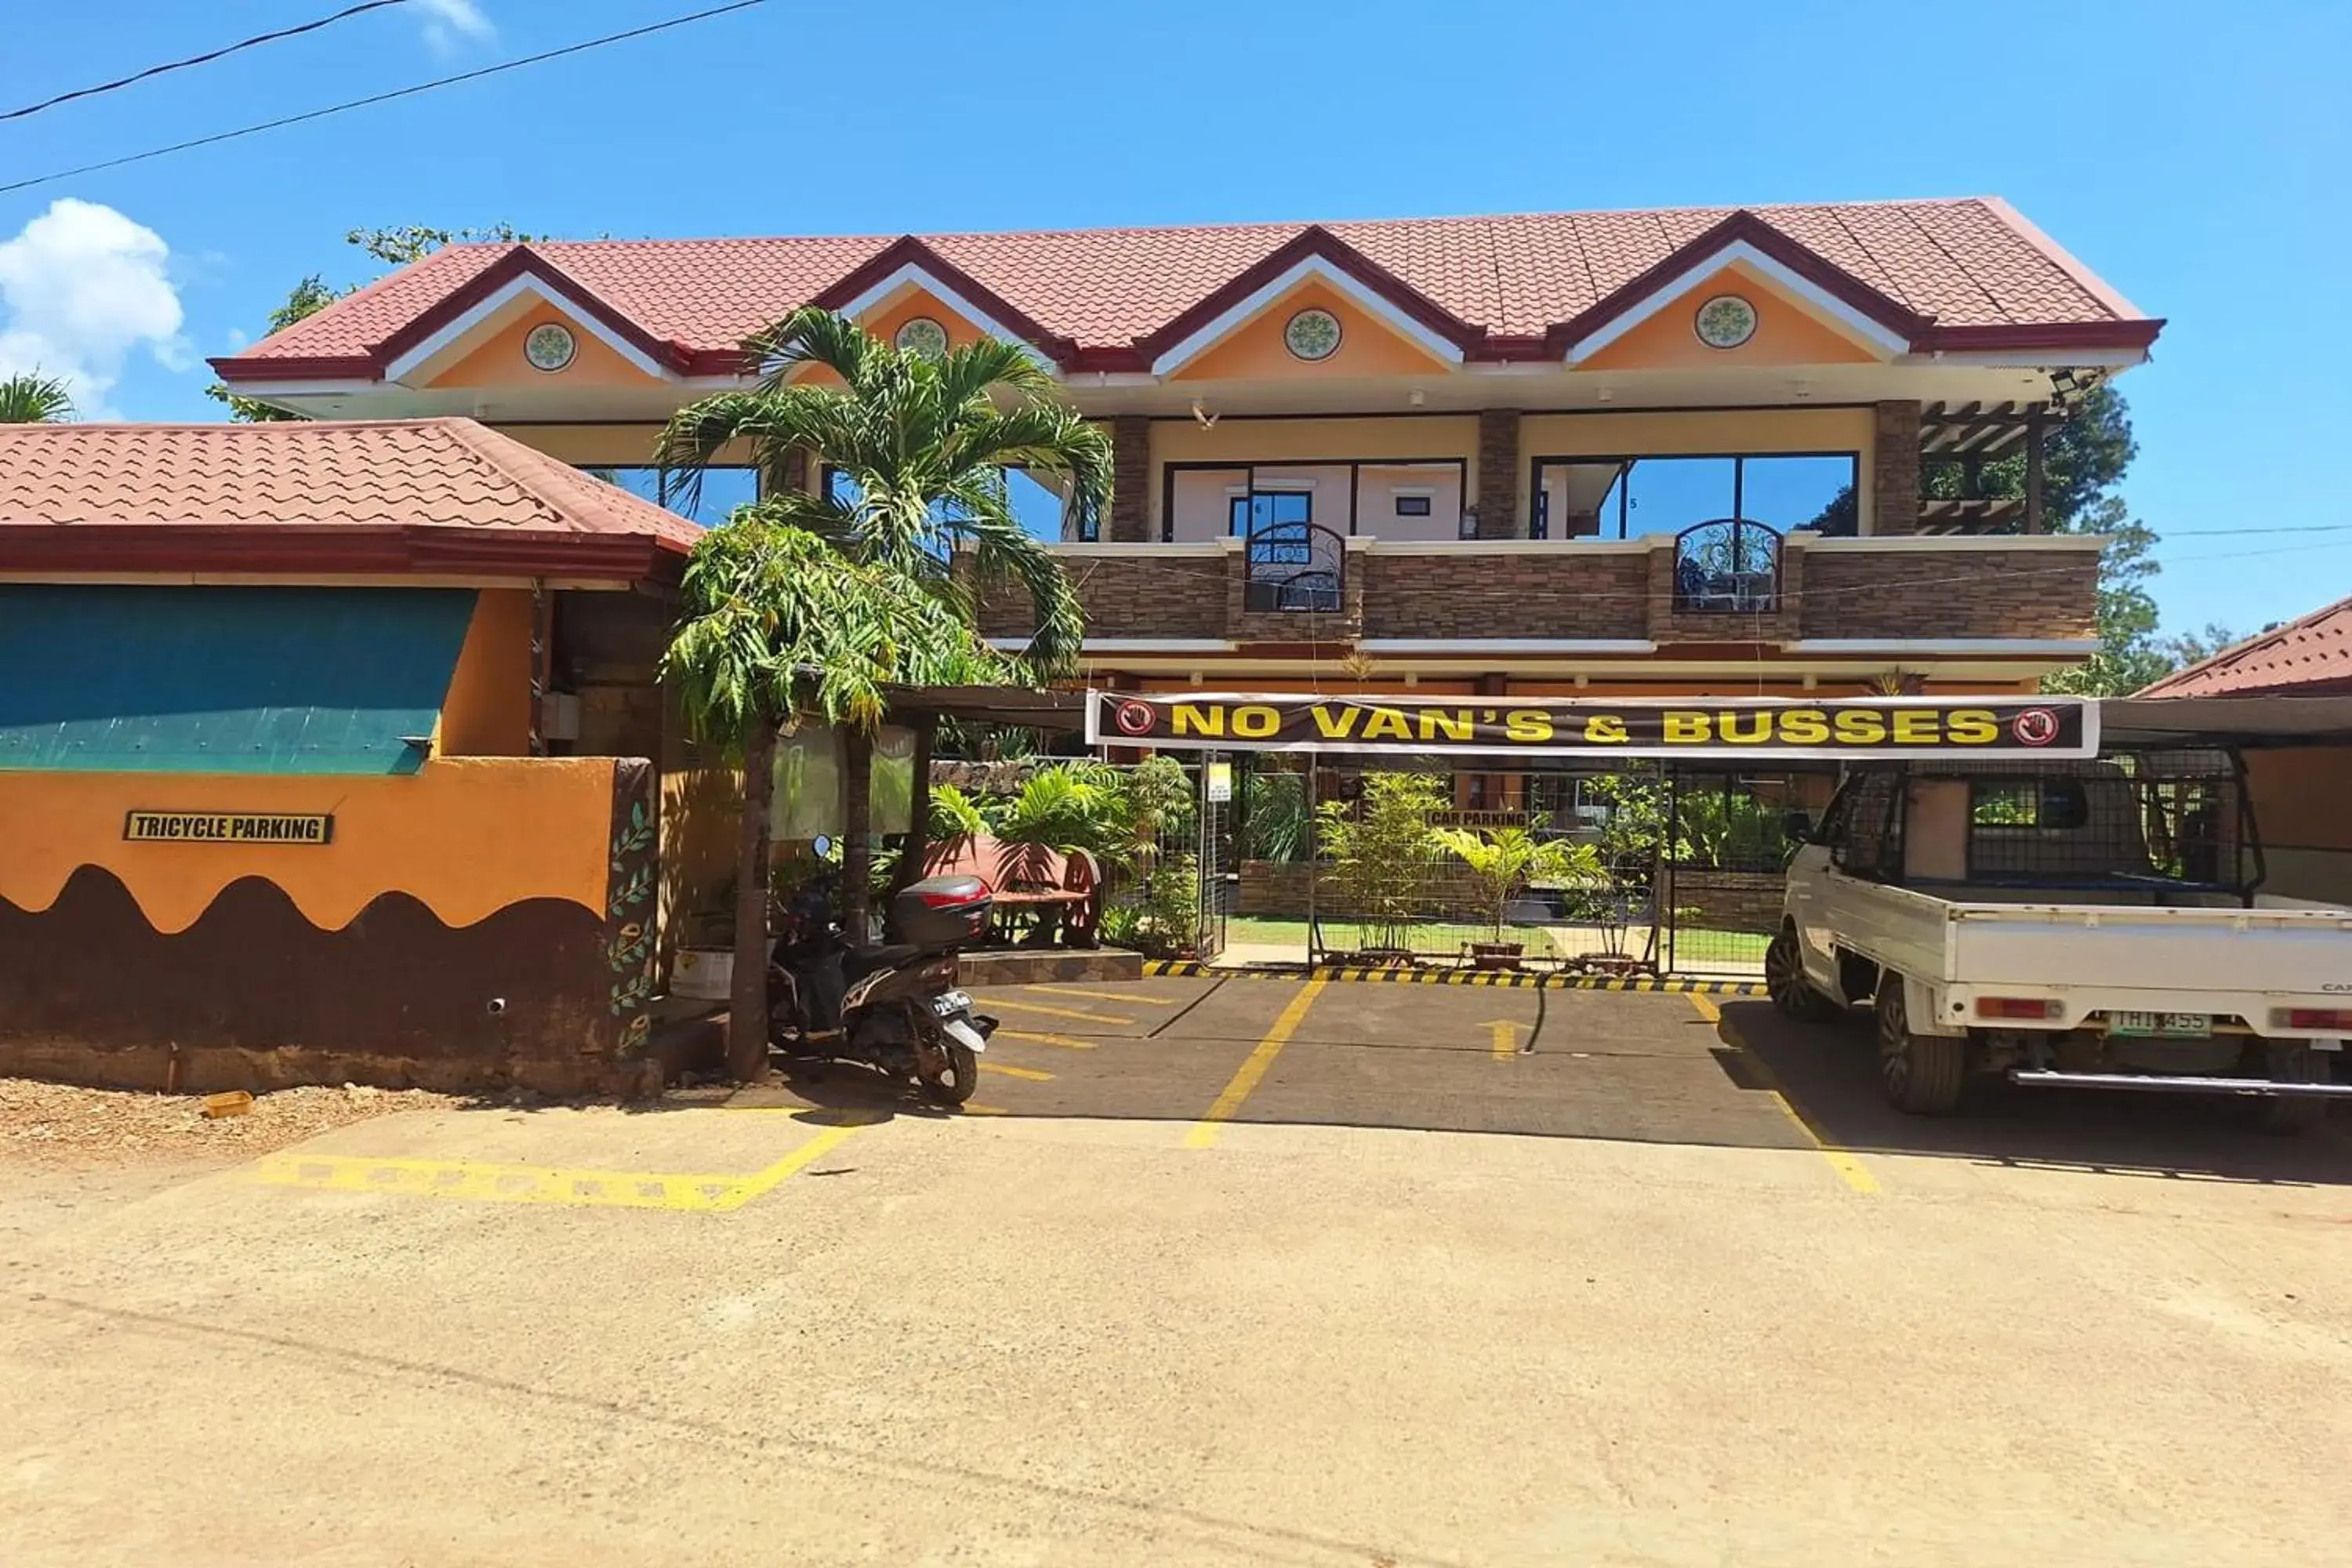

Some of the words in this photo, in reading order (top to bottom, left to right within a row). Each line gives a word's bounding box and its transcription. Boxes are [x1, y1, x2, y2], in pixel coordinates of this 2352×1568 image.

[1630, 498, 1638, 509] 5
[1171, 704, 1282, 737] NO
[1312, 706, 1553, 741] VAN'S
[1583, 714, 1630, 743] &
[1663, 710, 1998, 744] BUSSES
[136, 815, 227, 838] TRICYCLE
[230, 817, 319, 840] PARKING
[1432, 811, 1460, 824] CAR
[1464, 811, 1526, 826] PARKING
